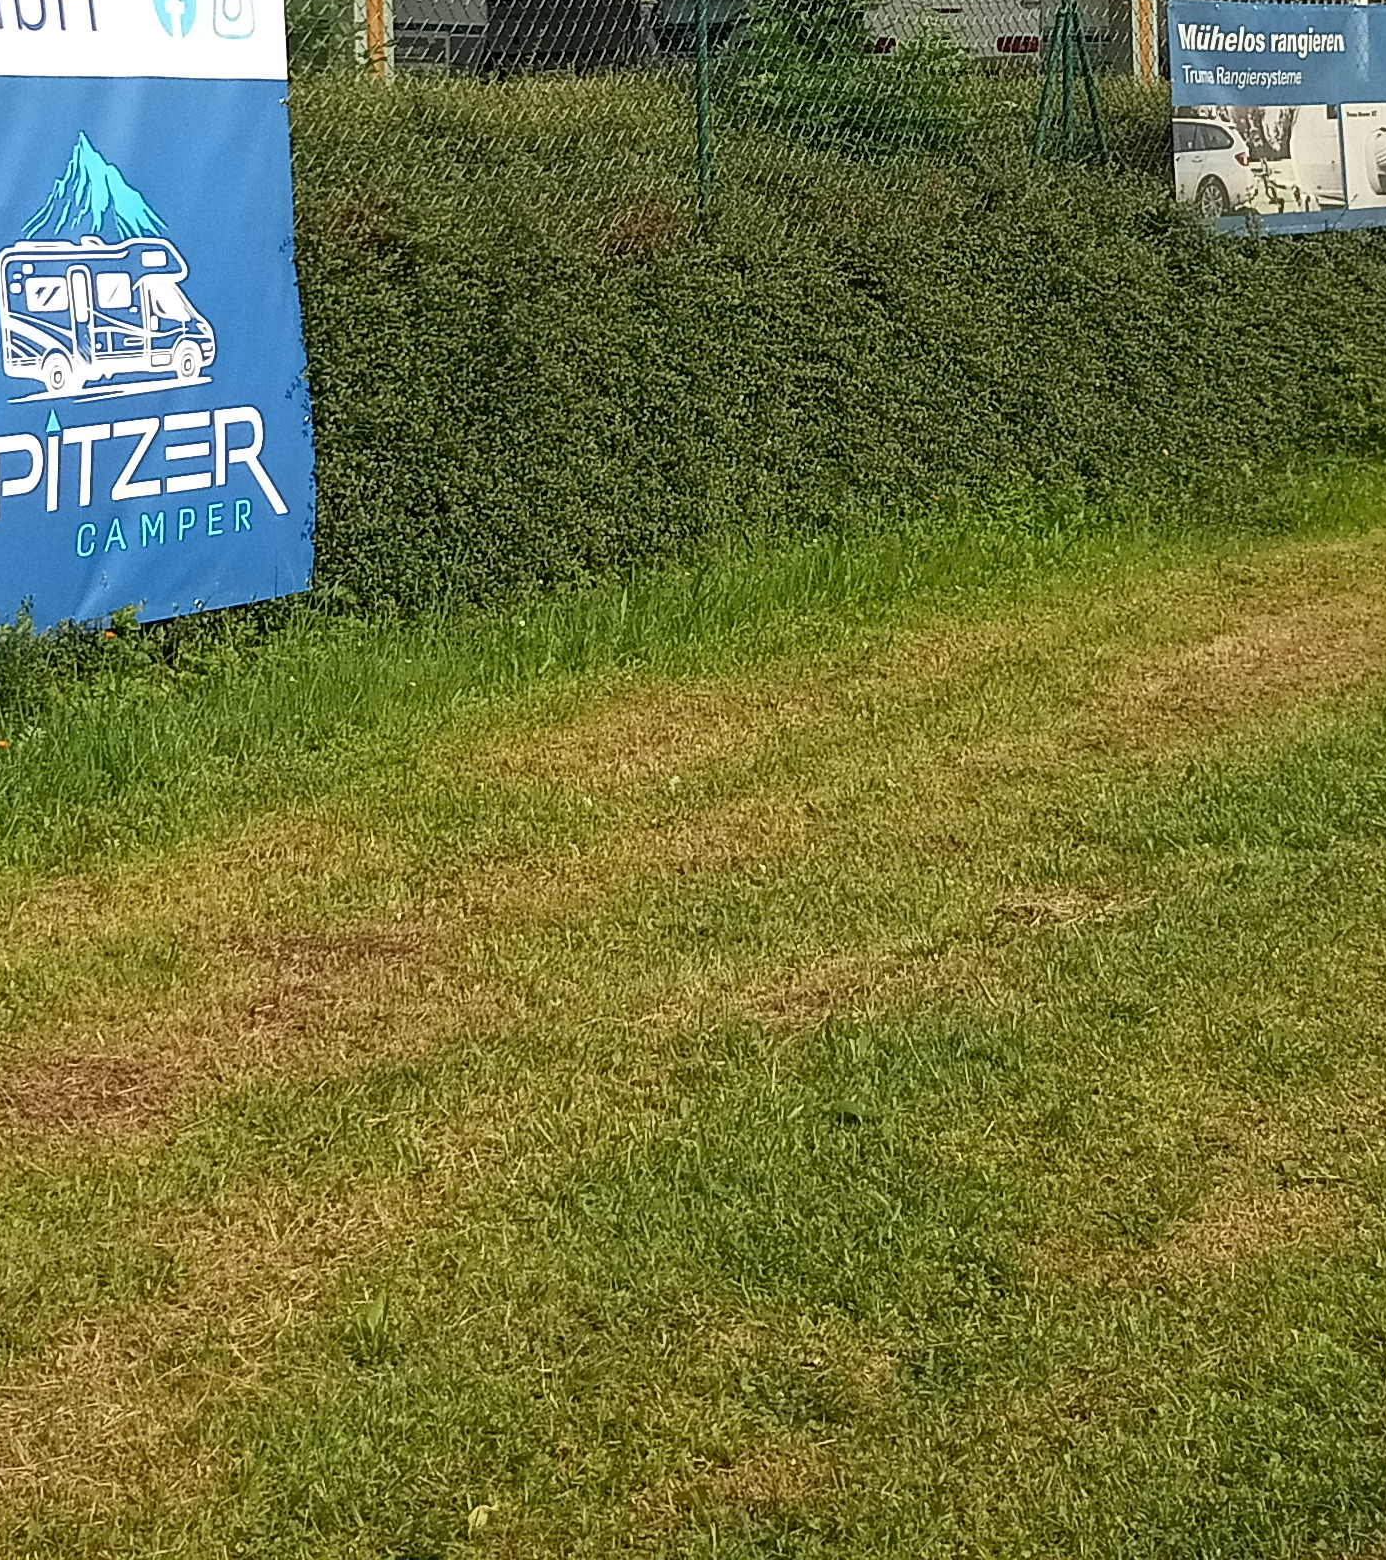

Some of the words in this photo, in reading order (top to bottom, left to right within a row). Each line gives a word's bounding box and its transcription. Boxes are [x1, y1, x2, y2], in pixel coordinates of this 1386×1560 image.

[1178, 24, 1266, 52] Mühelos
[1270, 27, 1346, 59] rangieren
[1181, 64, 1215, 84] Truma
[1216, 66, 1303, 89] Rangiersysteme
[76, 499, 253, 557] CAMPER
